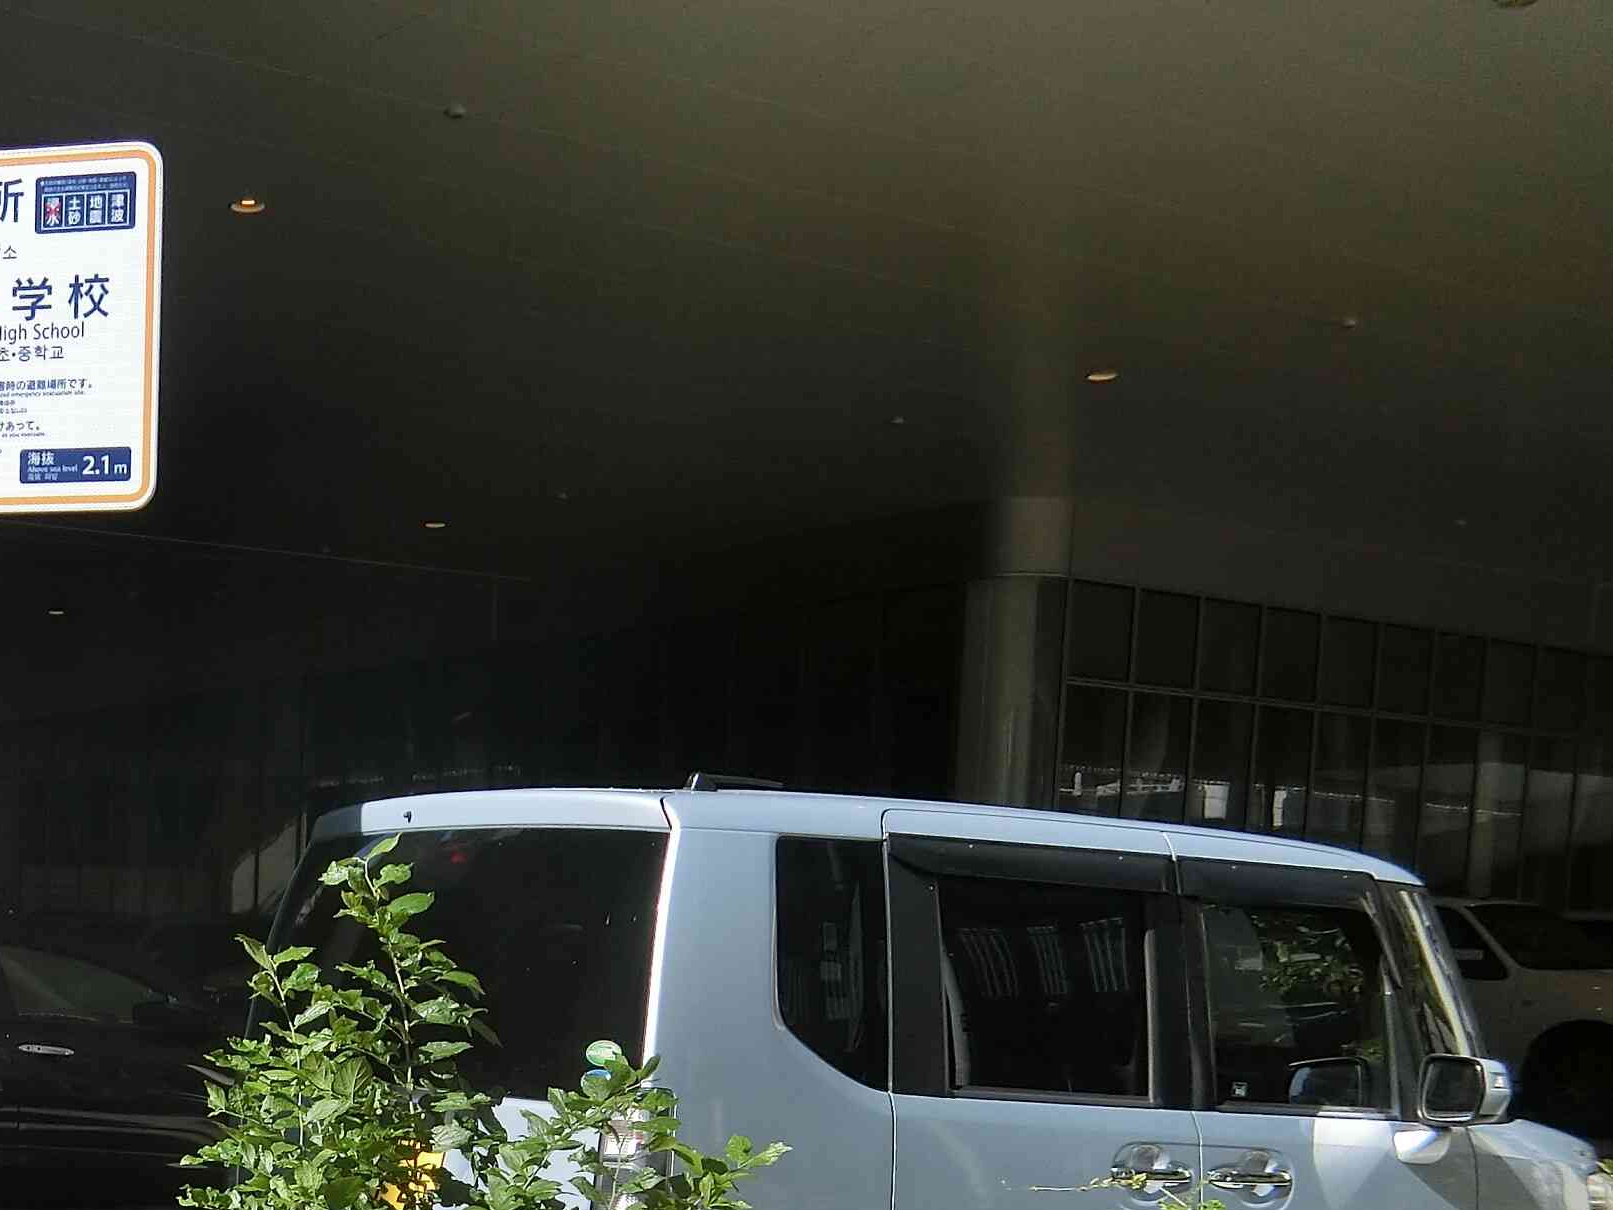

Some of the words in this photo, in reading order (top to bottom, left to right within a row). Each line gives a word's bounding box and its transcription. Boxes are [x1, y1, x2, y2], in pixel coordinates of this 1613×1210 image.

[68, 196, 81, 225] 土砂
[33, 321, 86, 340] School
[27, 451, 55, 466] 海抜
